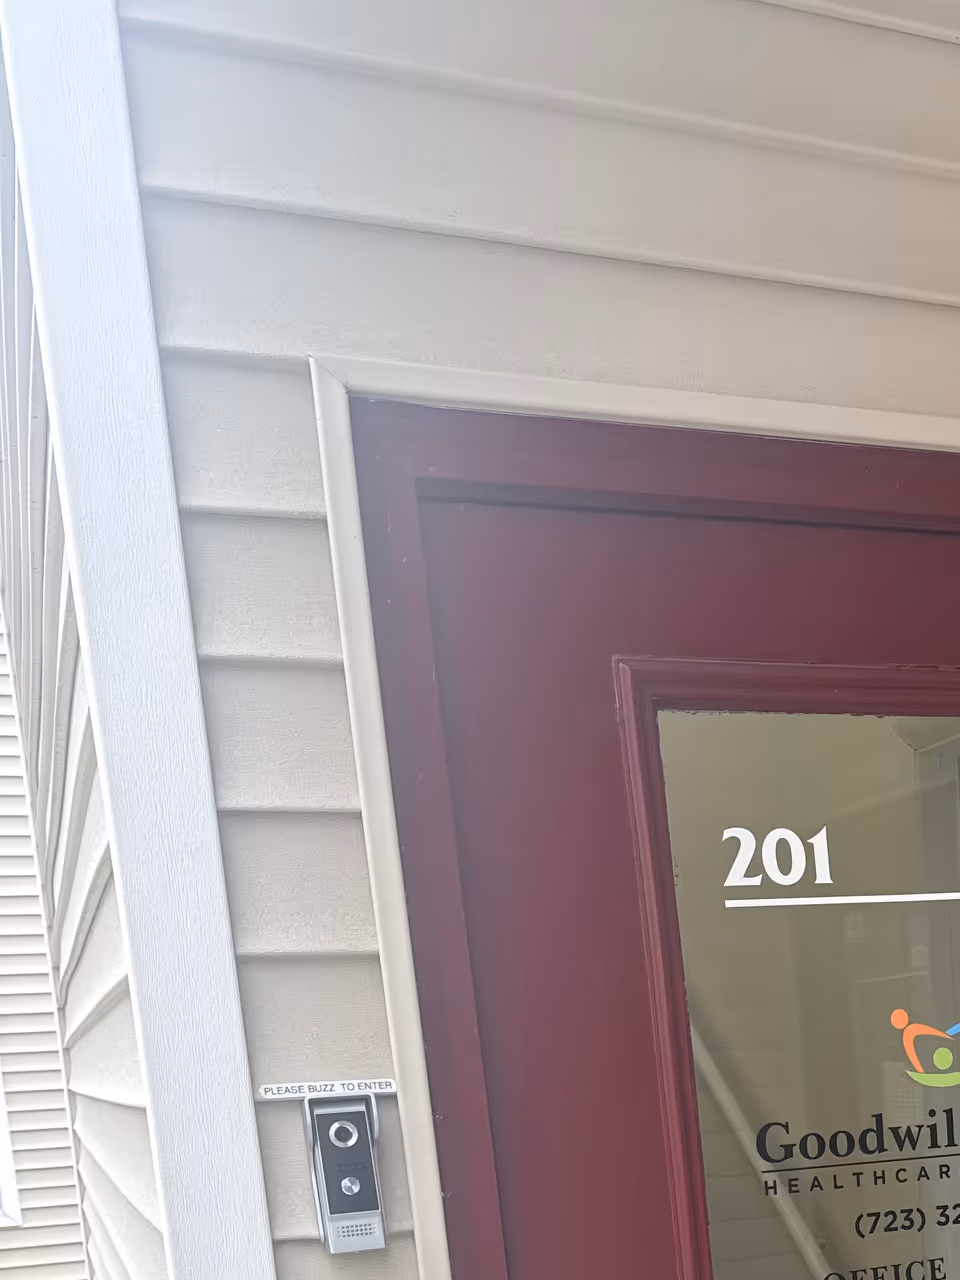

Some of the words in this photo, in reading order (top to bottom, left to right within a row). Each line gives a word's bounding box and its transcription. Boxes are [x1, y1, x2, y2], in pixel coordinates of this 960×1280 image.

[722, 826, 833, 887] 201
[264, 1085, 305, 1096] PLEASE
[308, 1083, 336, 1093] BUZZ
[340, 1083, 355, 1092] TO
[358, 1081, 393, 1091] ENTER
[854, 1207, 927, 1239] (723)
